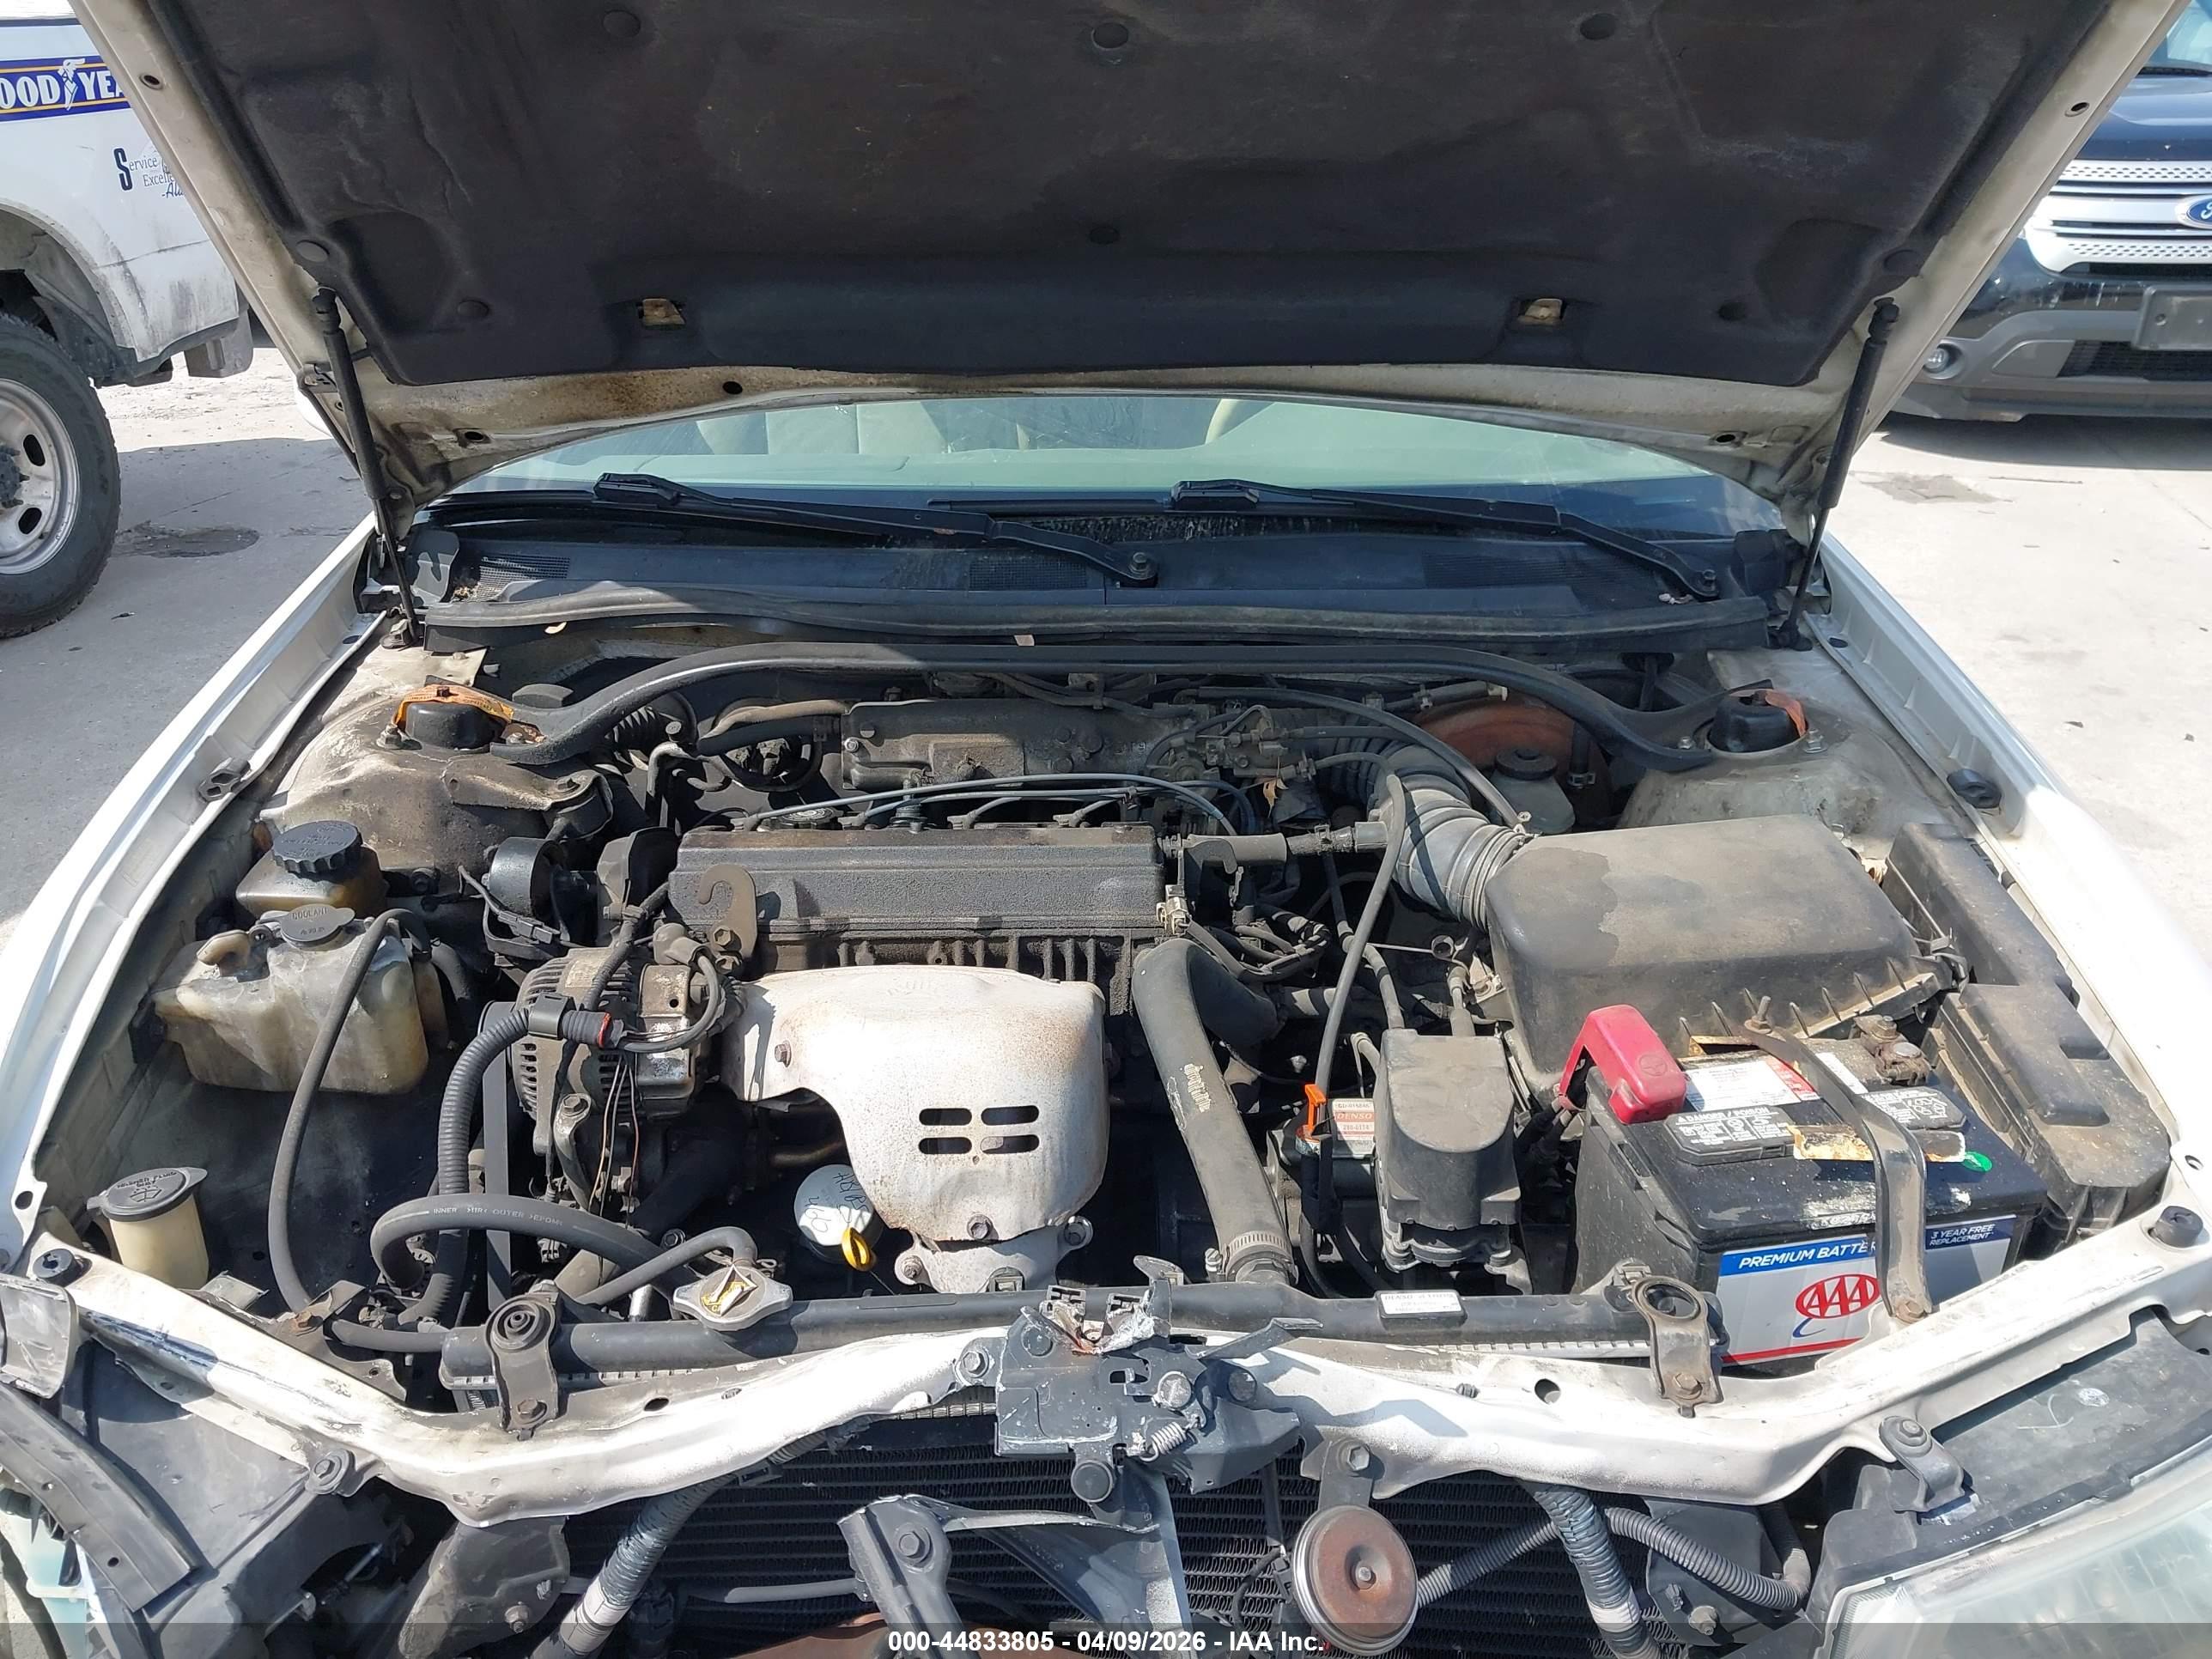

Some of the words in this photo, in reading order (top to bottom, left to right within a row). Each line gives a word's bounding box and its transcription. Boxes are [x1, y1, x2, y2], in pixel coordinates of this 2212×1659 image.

[113, 148, 158, 191] Service
[1930, 1231, 1939, 1240] 3
[1942, 1229, 1967, 1238] YEAR
[1967, 1224, 1996, 1235] FREE
[1739, 1249, 1815, 1269] PREMIUM
[1816, 1241, 1875, 1259] BATTER
[1804, 1275, 1881, 1318] AAA
